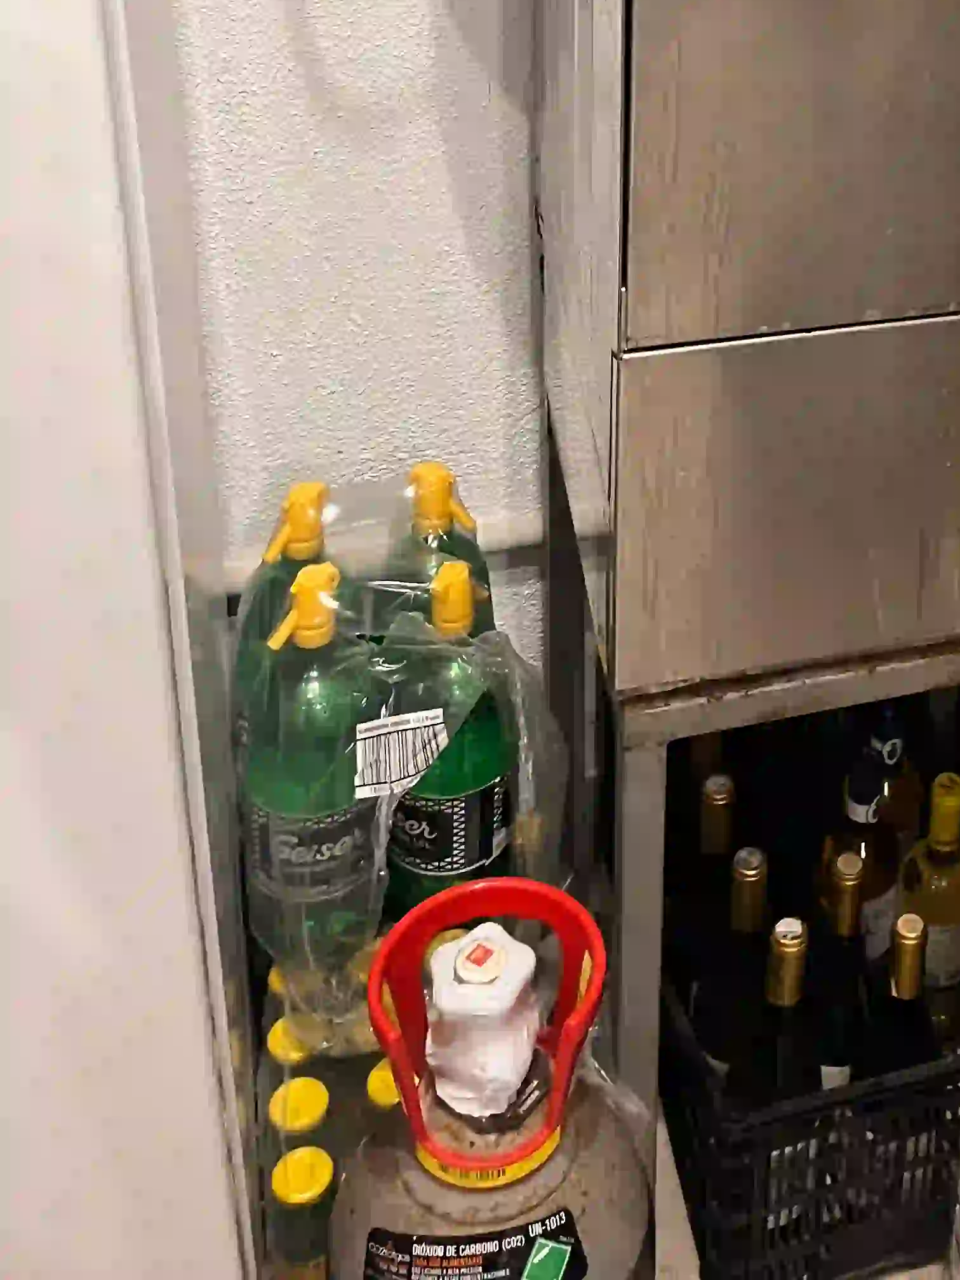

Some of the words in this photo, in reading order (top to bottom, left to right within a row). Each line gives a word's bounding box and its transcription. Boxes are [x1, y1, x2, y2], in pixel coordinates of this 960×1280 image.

[528, 1211, 567, 1237] UN-1013
[412, 1242, 444, 1257] DIÓXIDO
[446, 1245, 457, 1257] DE
[459, 1241, 499, 1257] CARBONO
